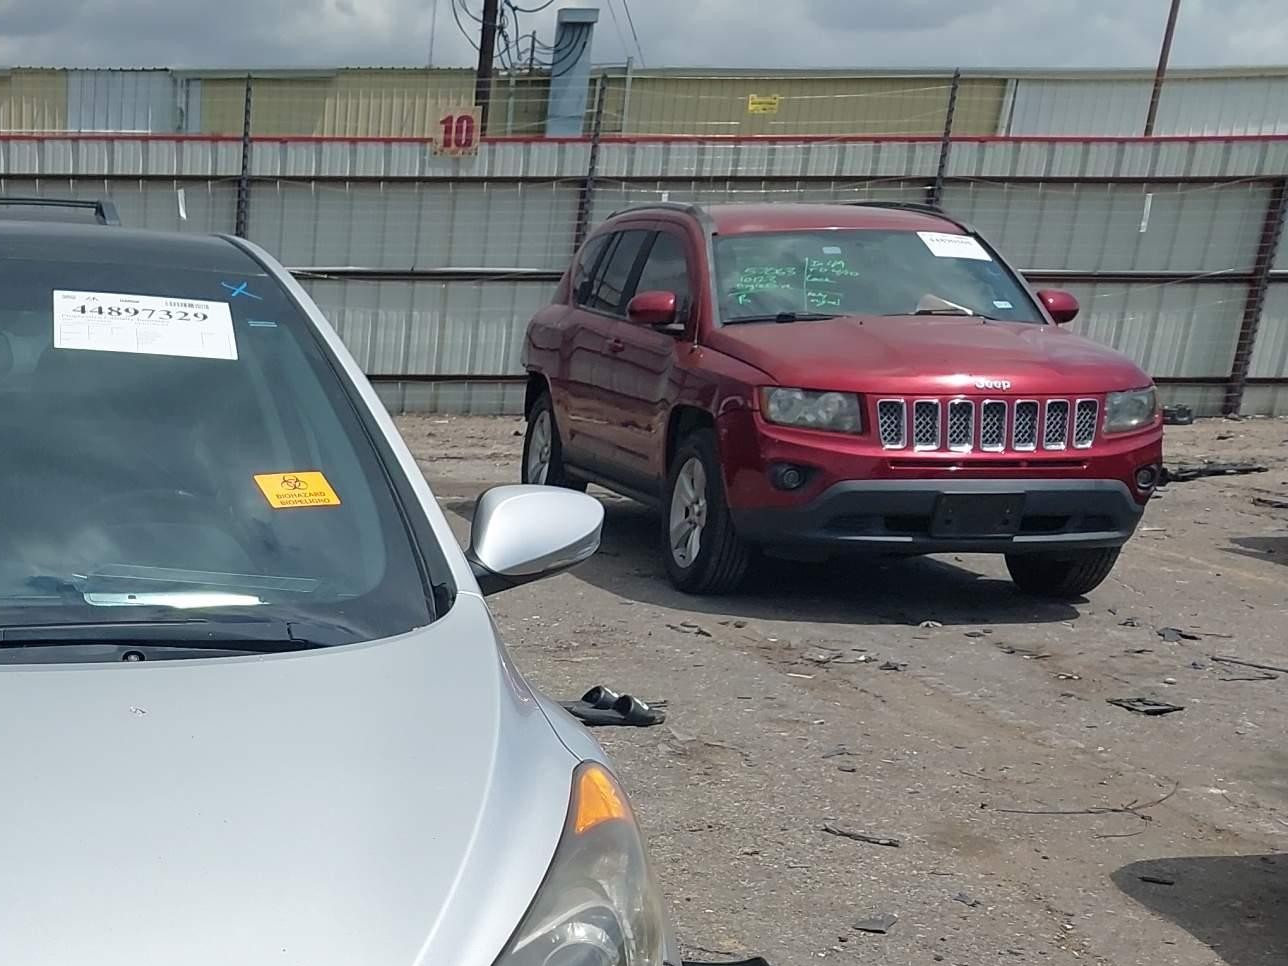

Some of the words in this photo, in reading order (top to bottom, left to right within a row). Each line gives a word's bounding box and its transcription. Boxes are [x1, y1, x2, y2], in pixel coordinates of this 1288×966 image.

[440, 114, 474, 148] 10
[72, 304, 209, 322] 44897329
[975, 379, 1011, 391] Jeep
[275, 491, 326, 499] BIOHAZARD
